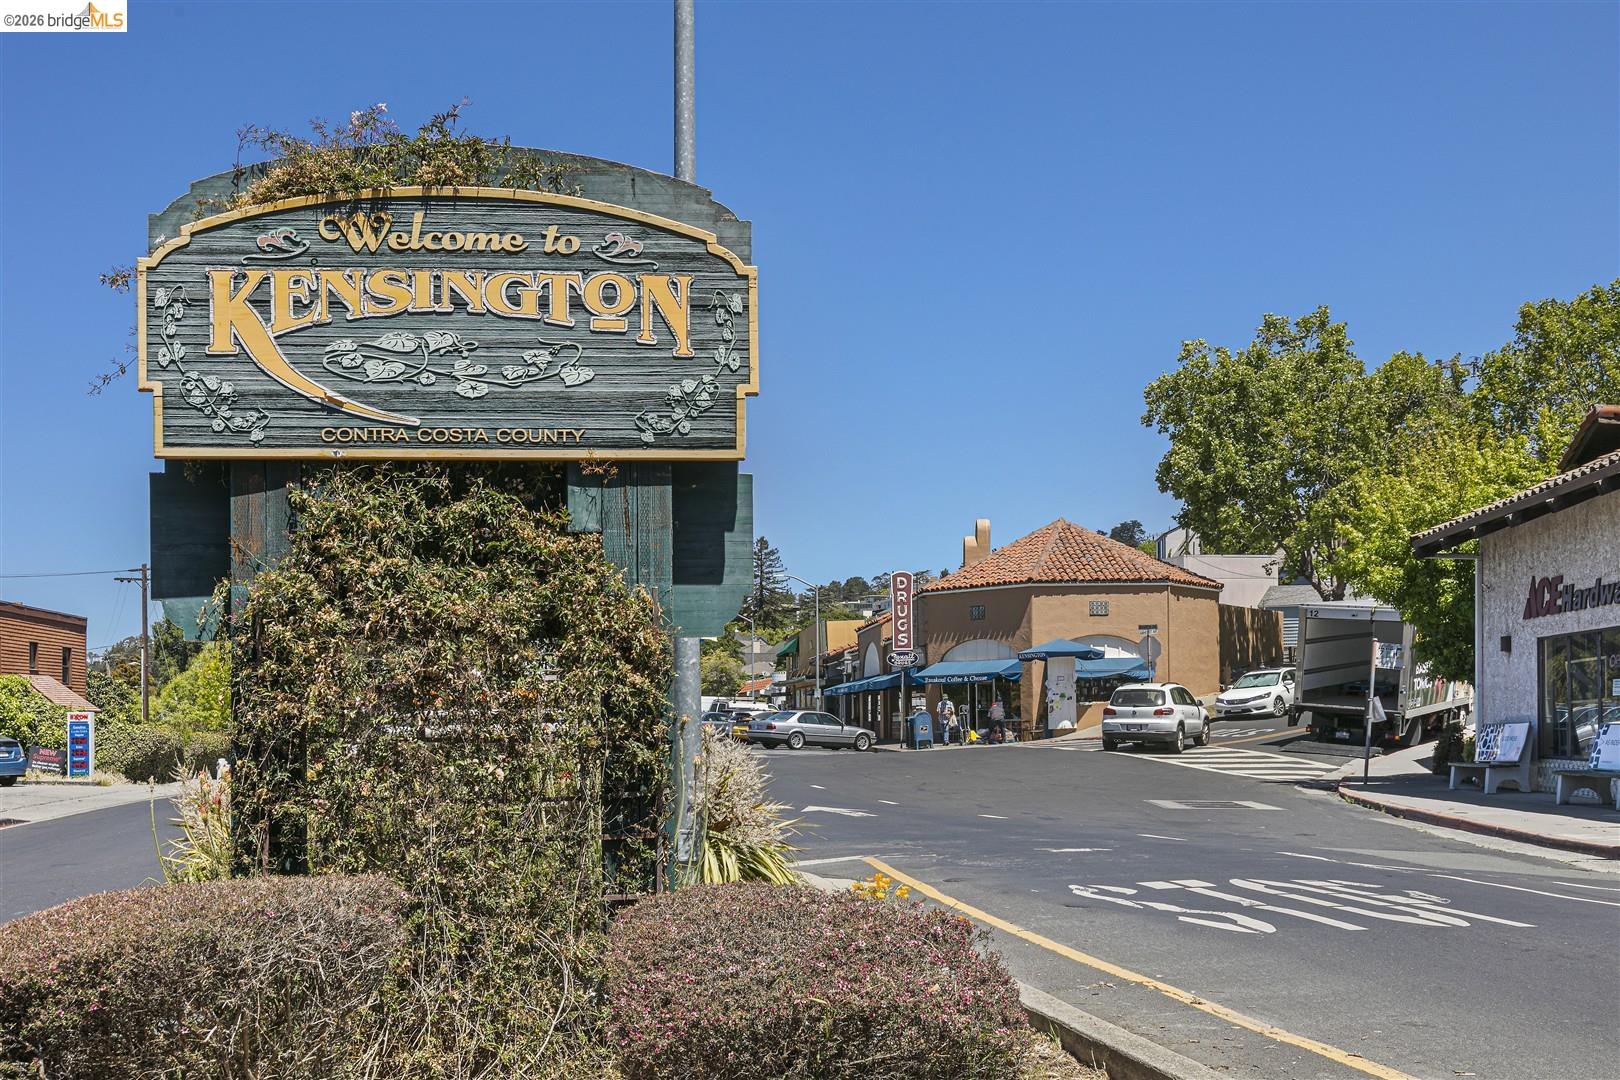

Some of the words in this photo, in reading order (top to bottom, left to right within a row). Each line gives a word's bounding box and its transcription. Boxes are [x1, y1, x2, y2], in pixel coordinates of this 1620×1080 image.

[319, 210, 529, 254] Welcome
[541, 224, 581, 255] to
[205, 266, 696, 426] KENSINGTON
[321, 426, 409, 443] CONTRA
[416, 427, 488, 443] COSTA
[495, 427, 586, 444] COUNTY
[896, 576, 909, 646] DRUGS
[1523, 575, 1563, 619] ACE
[39, 748, 57, 757] NEW
[1068, 878, 1537, 934] STOP
